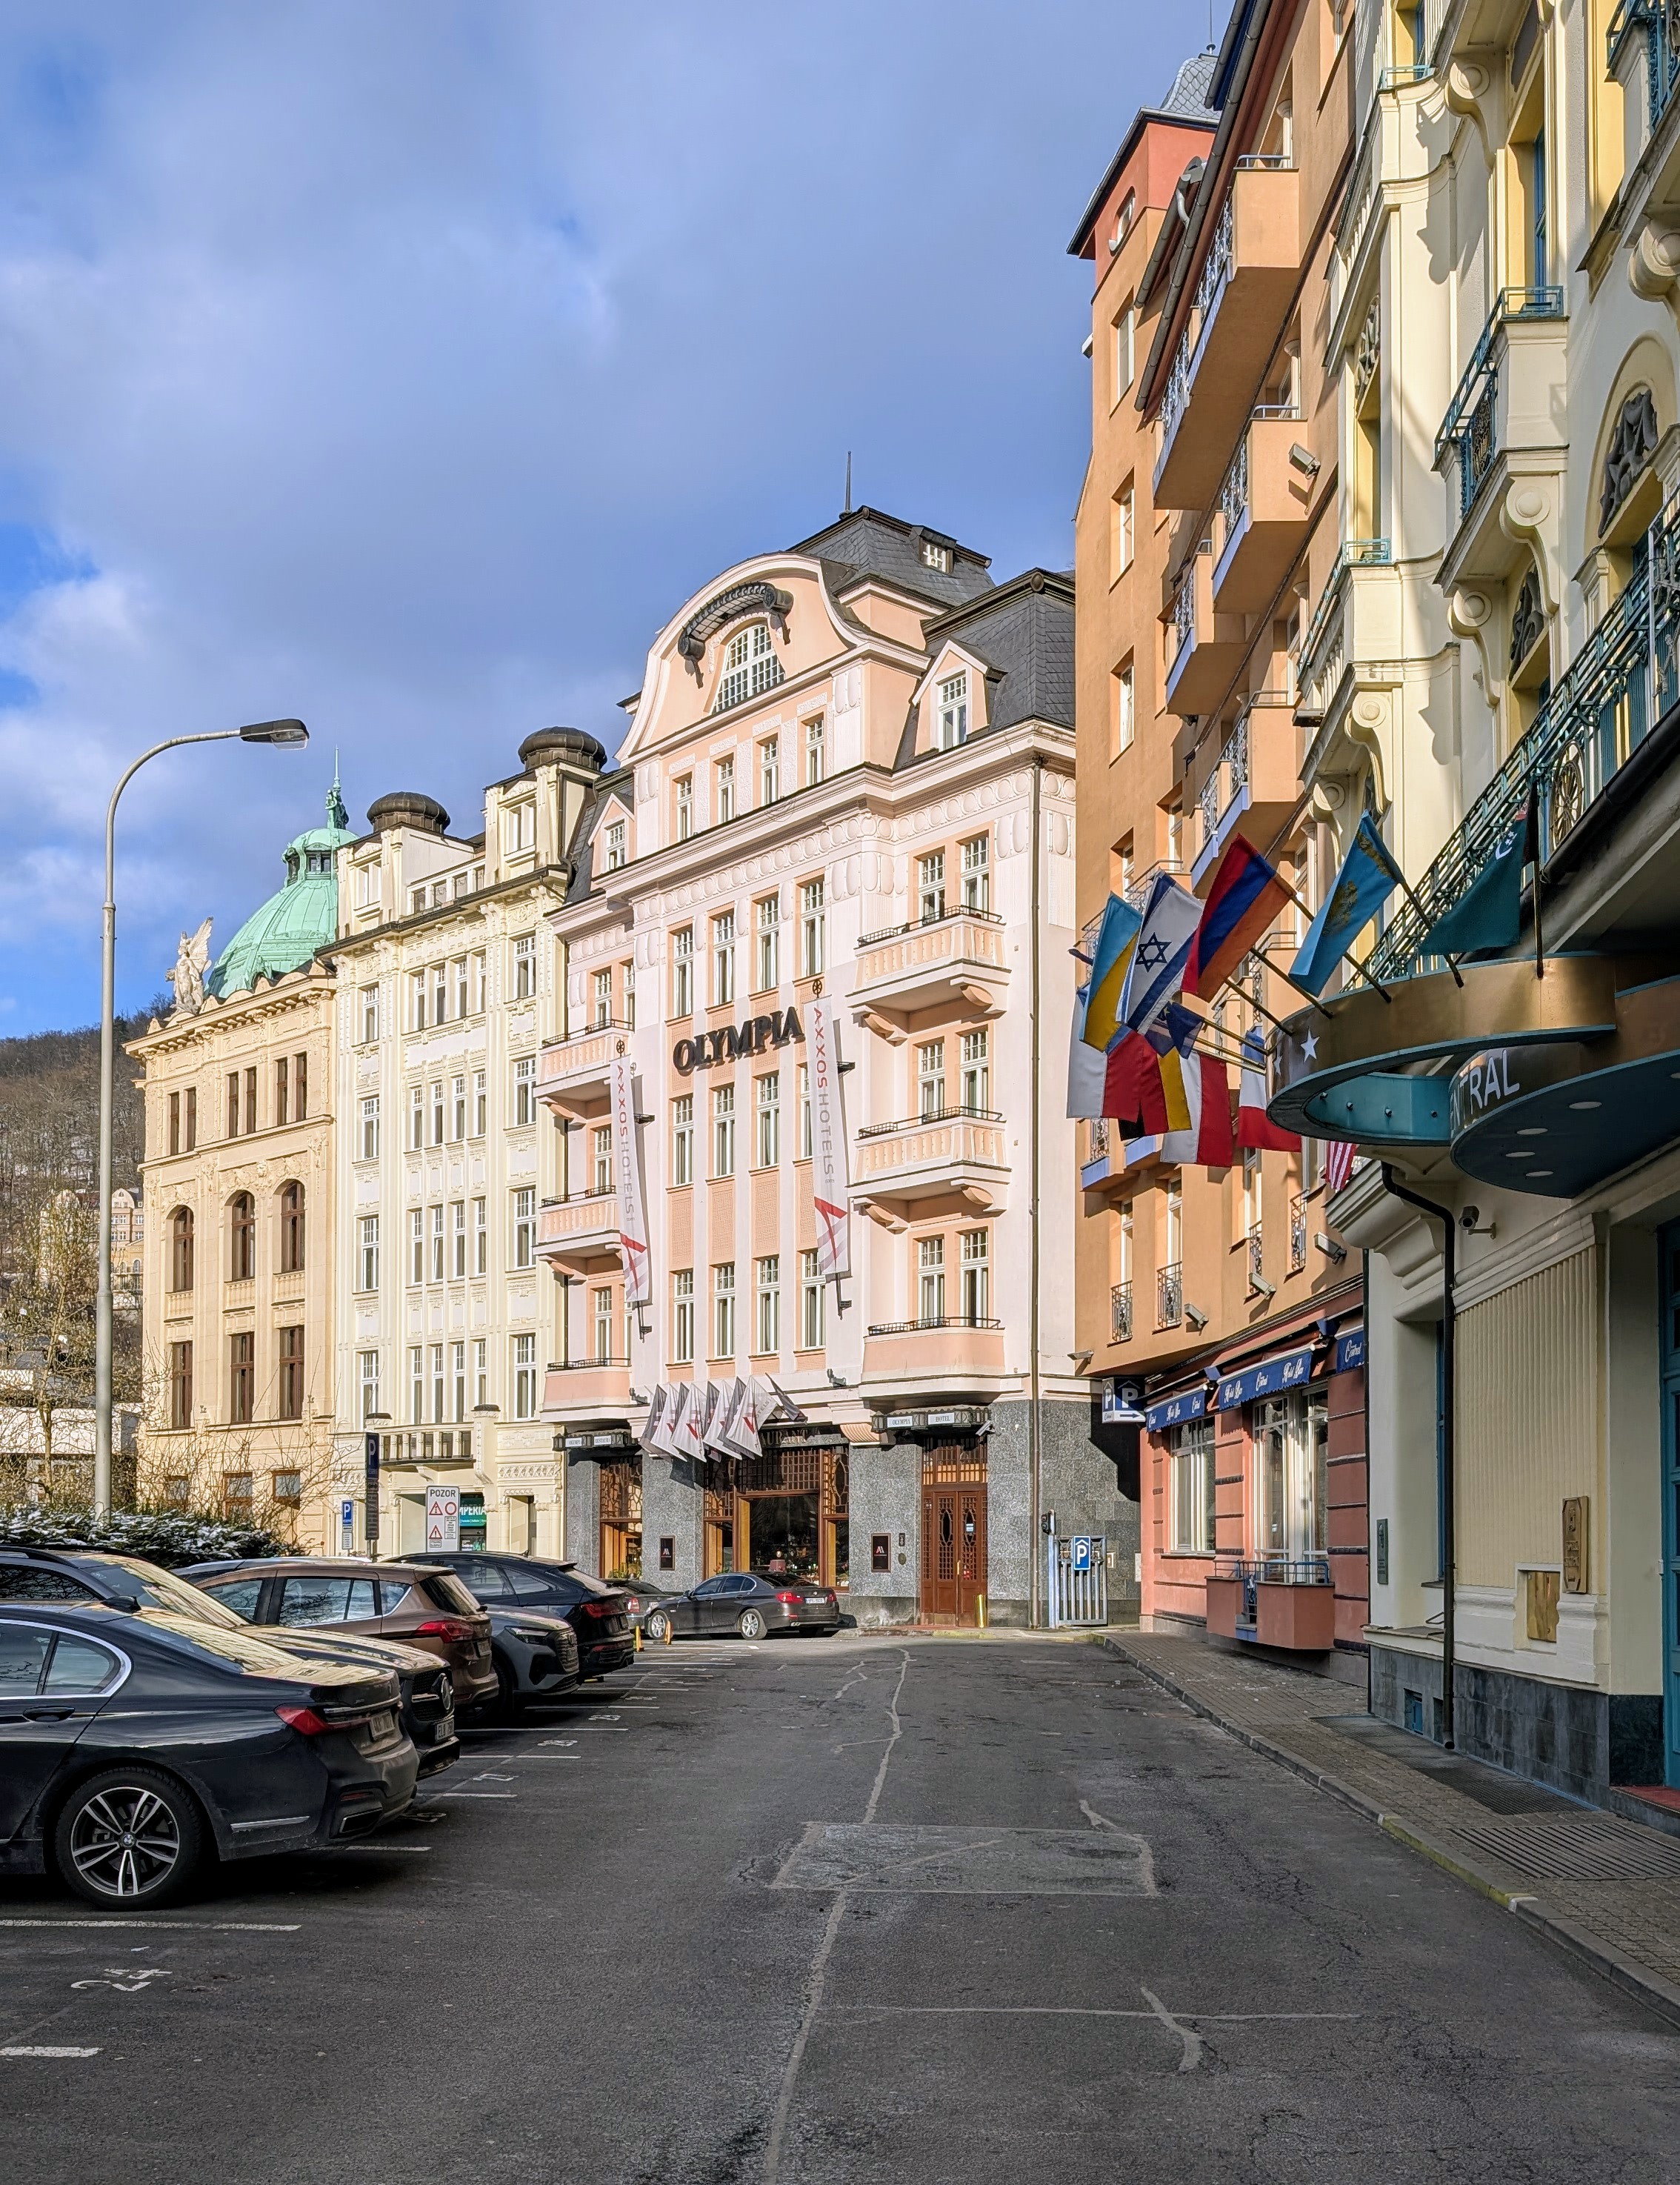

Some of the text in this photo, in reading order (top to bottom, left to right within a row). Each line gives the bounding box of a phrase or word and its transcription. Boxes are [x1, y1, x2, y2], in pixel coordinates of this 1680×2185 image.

[673, 1006, 805, 1071] OLYMPIA
[1104, 1389, 1112, 1409] P
[1121, 1388, 1139, 1409] P
[368, 1439, 376, 1466] P
[430, 1489, 456, 1497] POZOR
[344, 1503, 351, 1518] P
[1076, 1545, 1087, 1565] P
